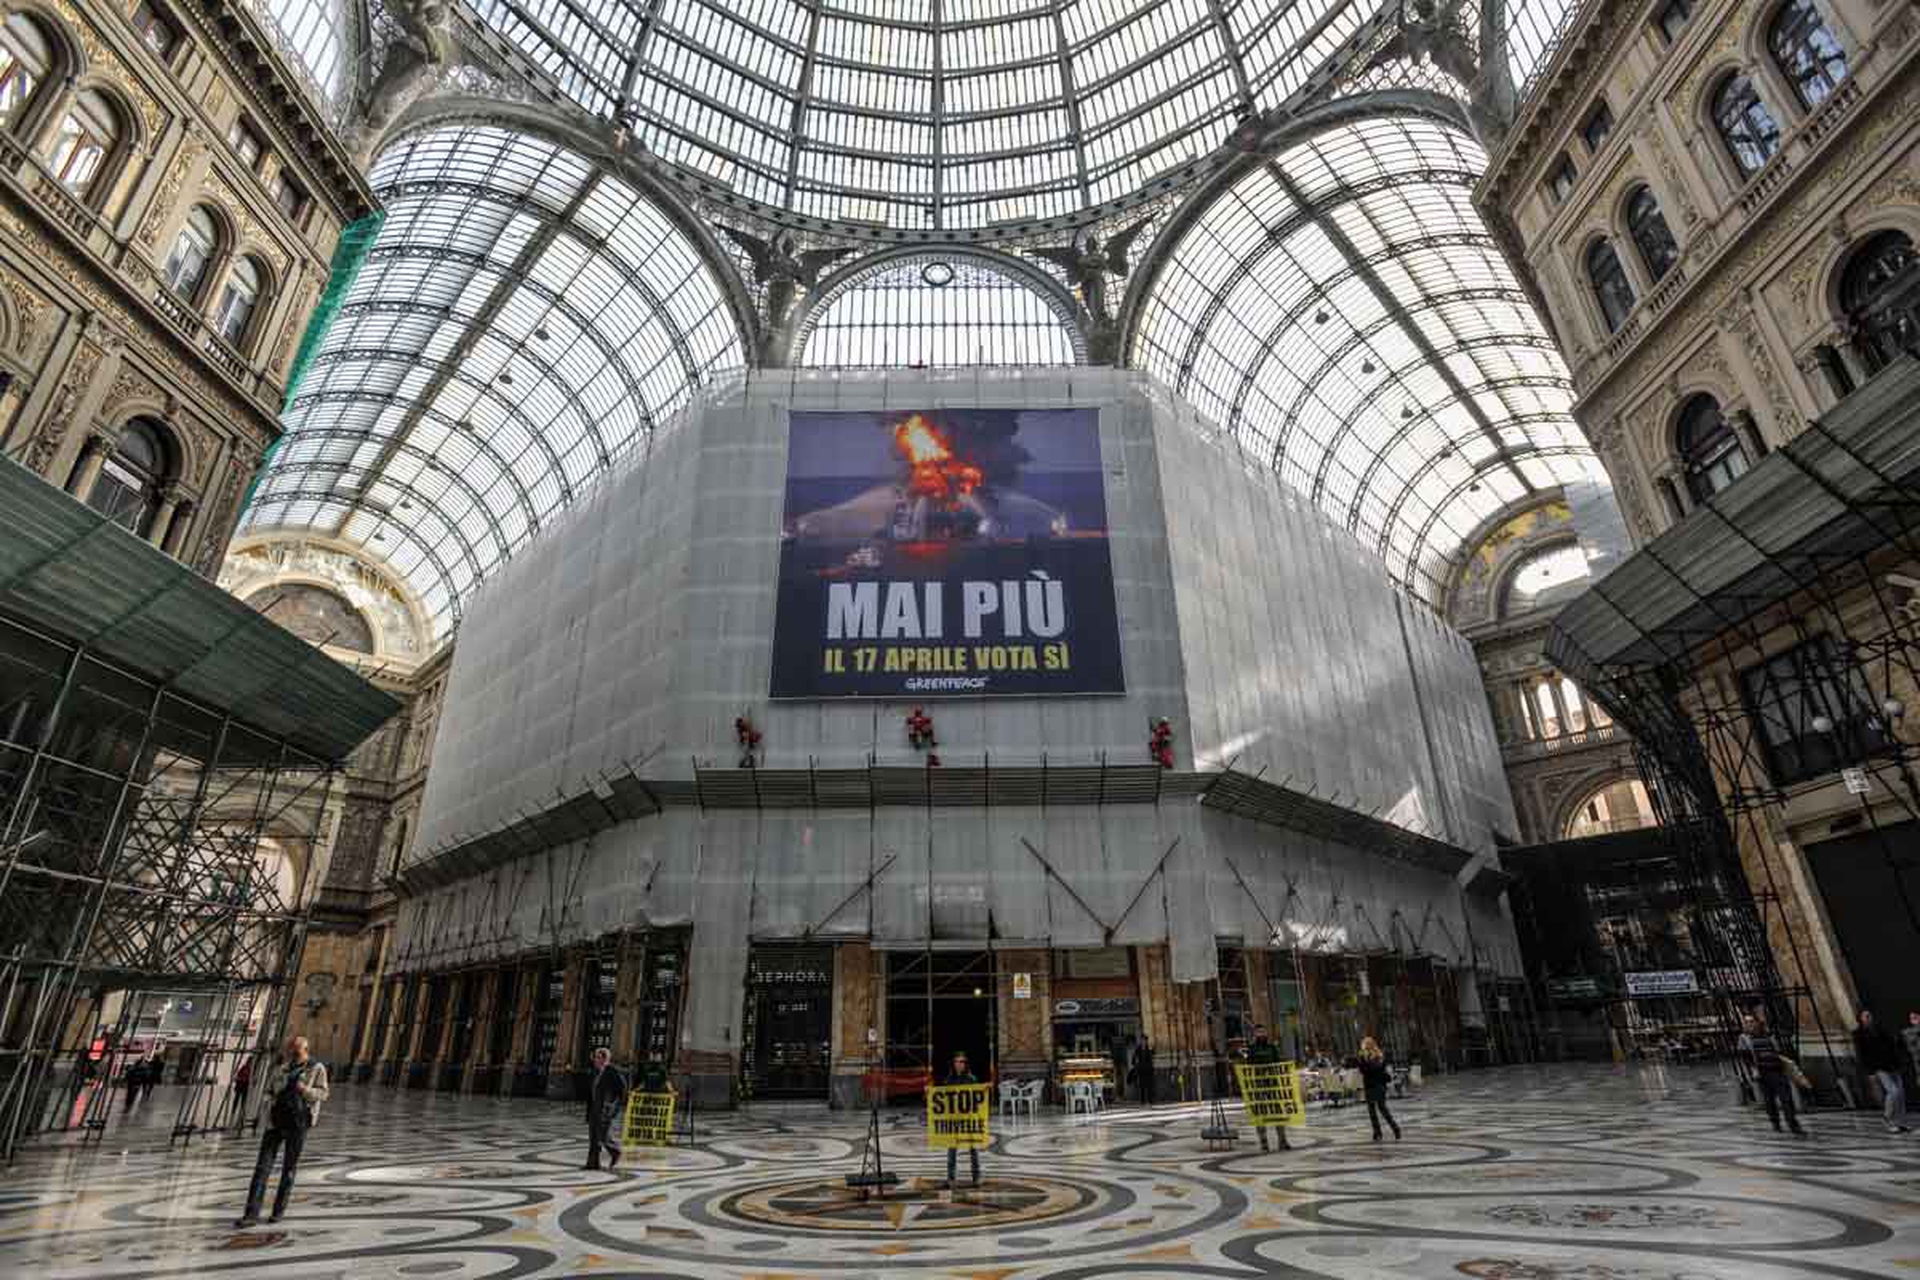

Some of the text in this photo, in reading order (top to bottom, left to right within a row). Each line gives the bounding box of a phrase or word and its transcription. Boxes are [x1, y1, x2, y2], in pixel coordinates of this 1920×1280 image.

[827, 570, 1066, 639] MAI PIÙ
[824, 641, 1070, 674] IL 17 APRILE VOTA SÌ
[905, 676, 989, 691] GREENPEACE
[932, 1090, 985, 1114] STOP
[934, 1118, 986, 1134] TRIVELLE
